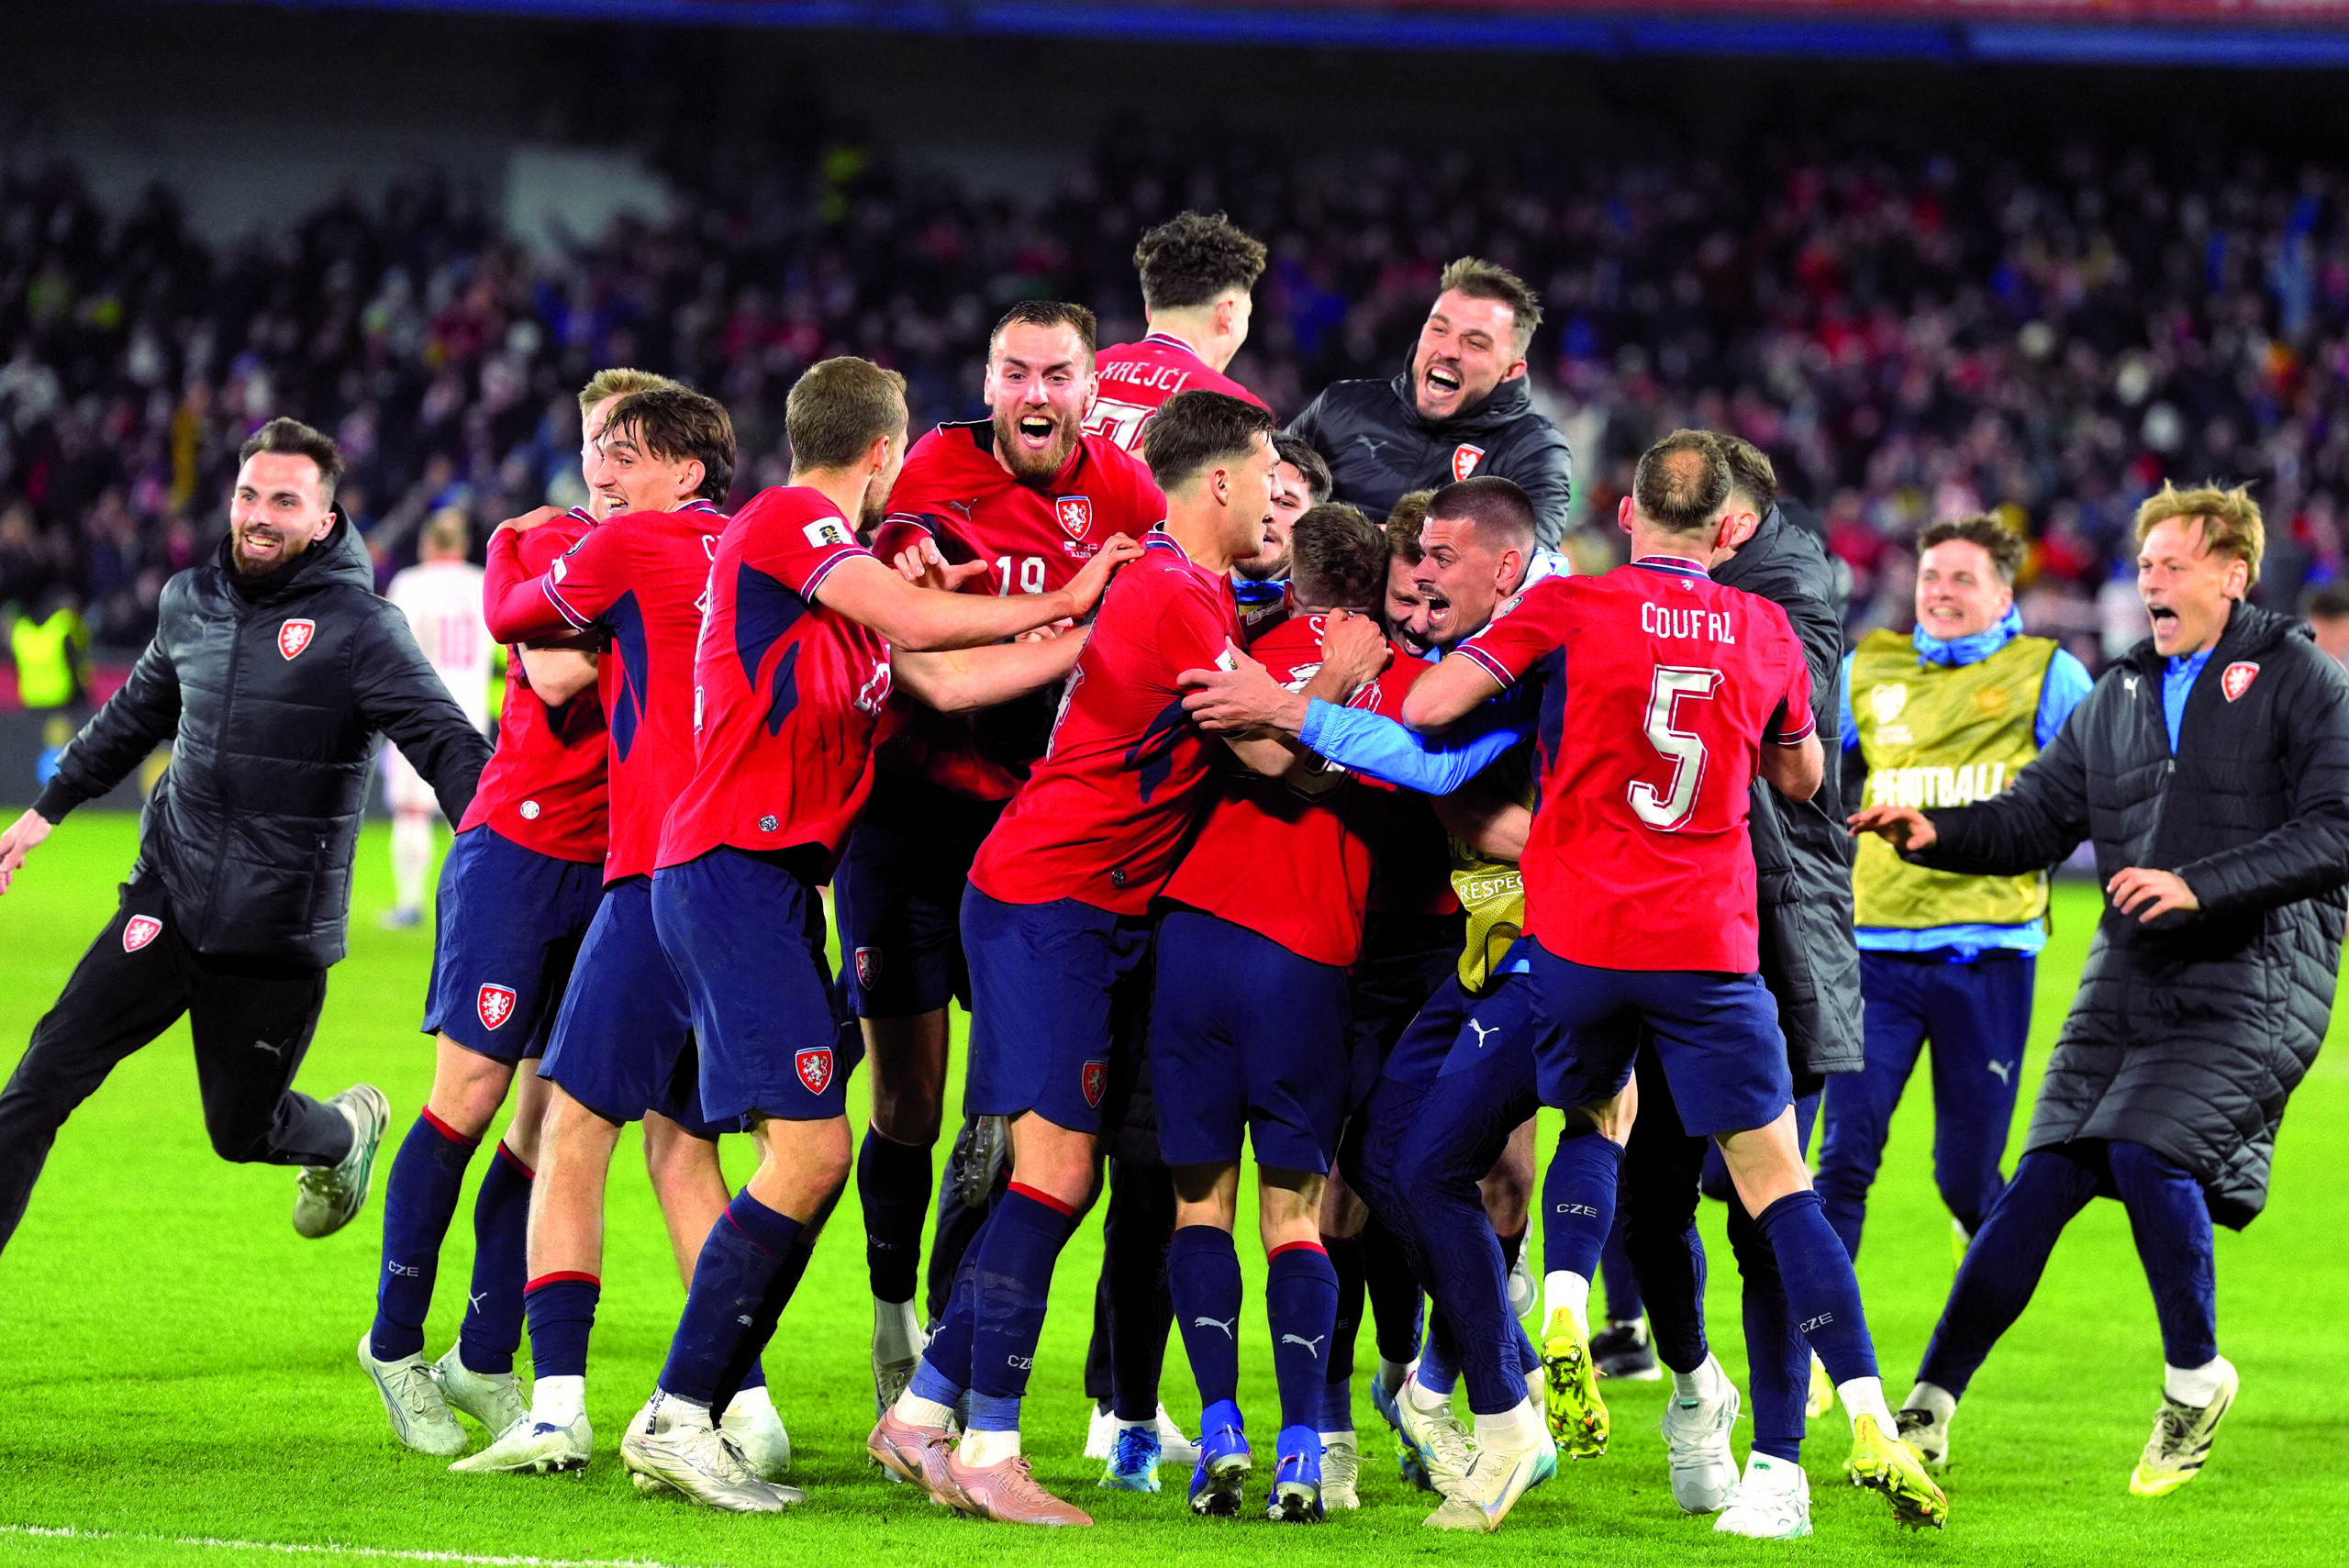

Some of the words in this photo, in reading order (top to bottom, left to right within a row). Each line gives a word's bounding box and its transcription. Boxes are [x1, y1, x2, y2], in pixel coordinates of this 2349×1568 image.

[1642, 602, 1736, 644] COUFAL
[1627, 663, 1725, 832] 5
[1556, 1203, 1598, 1218] CZE
[388, 1260, 419, 1277] CZE
[1799, 1312, 1833, 1333] CZE
